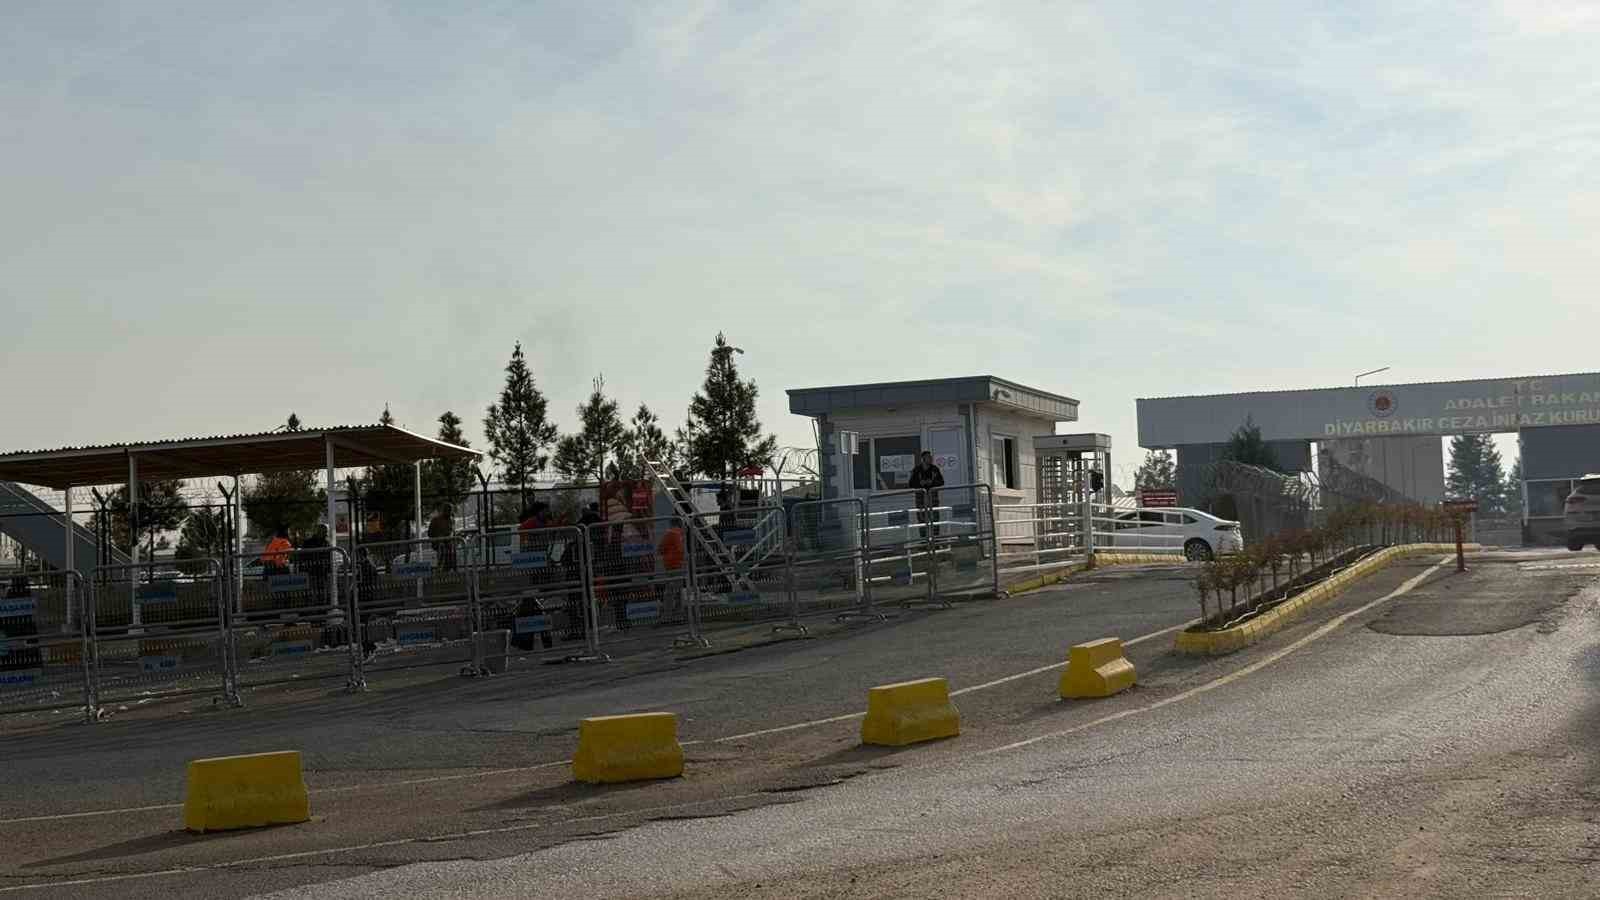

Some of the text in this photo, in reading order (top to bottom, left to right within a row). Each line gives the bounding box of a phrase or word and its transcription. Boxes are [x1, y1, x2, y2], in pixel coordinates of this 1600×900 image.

[1443, 395, 1526, 410] ADALET
[1325, 418, 1433, 436] DİYARBAKIR
[1438, 415, 1488, 429] CEZA
